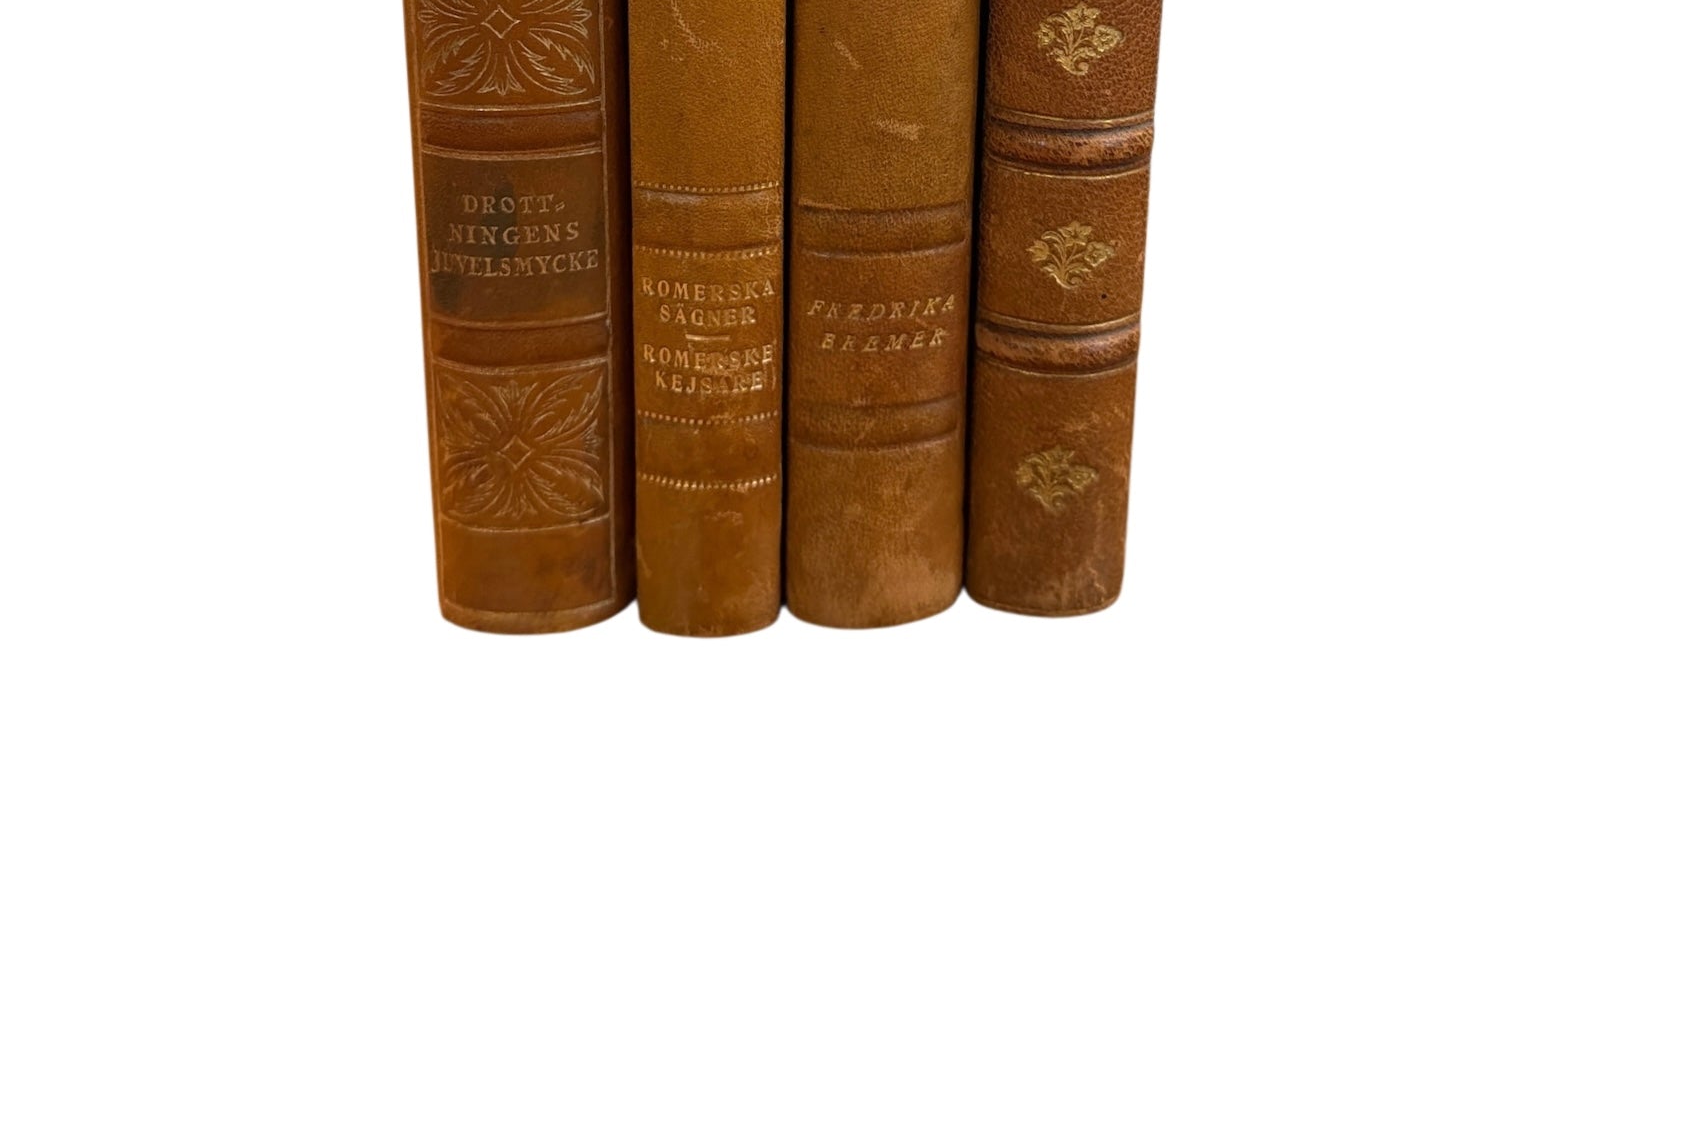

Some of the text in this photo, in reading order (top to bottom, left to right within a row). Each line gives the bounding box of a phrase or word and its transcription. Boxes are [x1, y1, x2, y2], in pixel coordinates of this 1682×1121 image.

[449, 221, 579, 245] NINGENS
[431, 248, 599, 277] JUVELSMYCKE
[642, 277, 775, 302] ROMERSKA
[660, 302, 756, 326] SÄGNER
[821, 327, 947, 352] BREMER
[643, 344, 774, 370] ROMERSKE
[655, 370, 763, 394] KEJSARE
